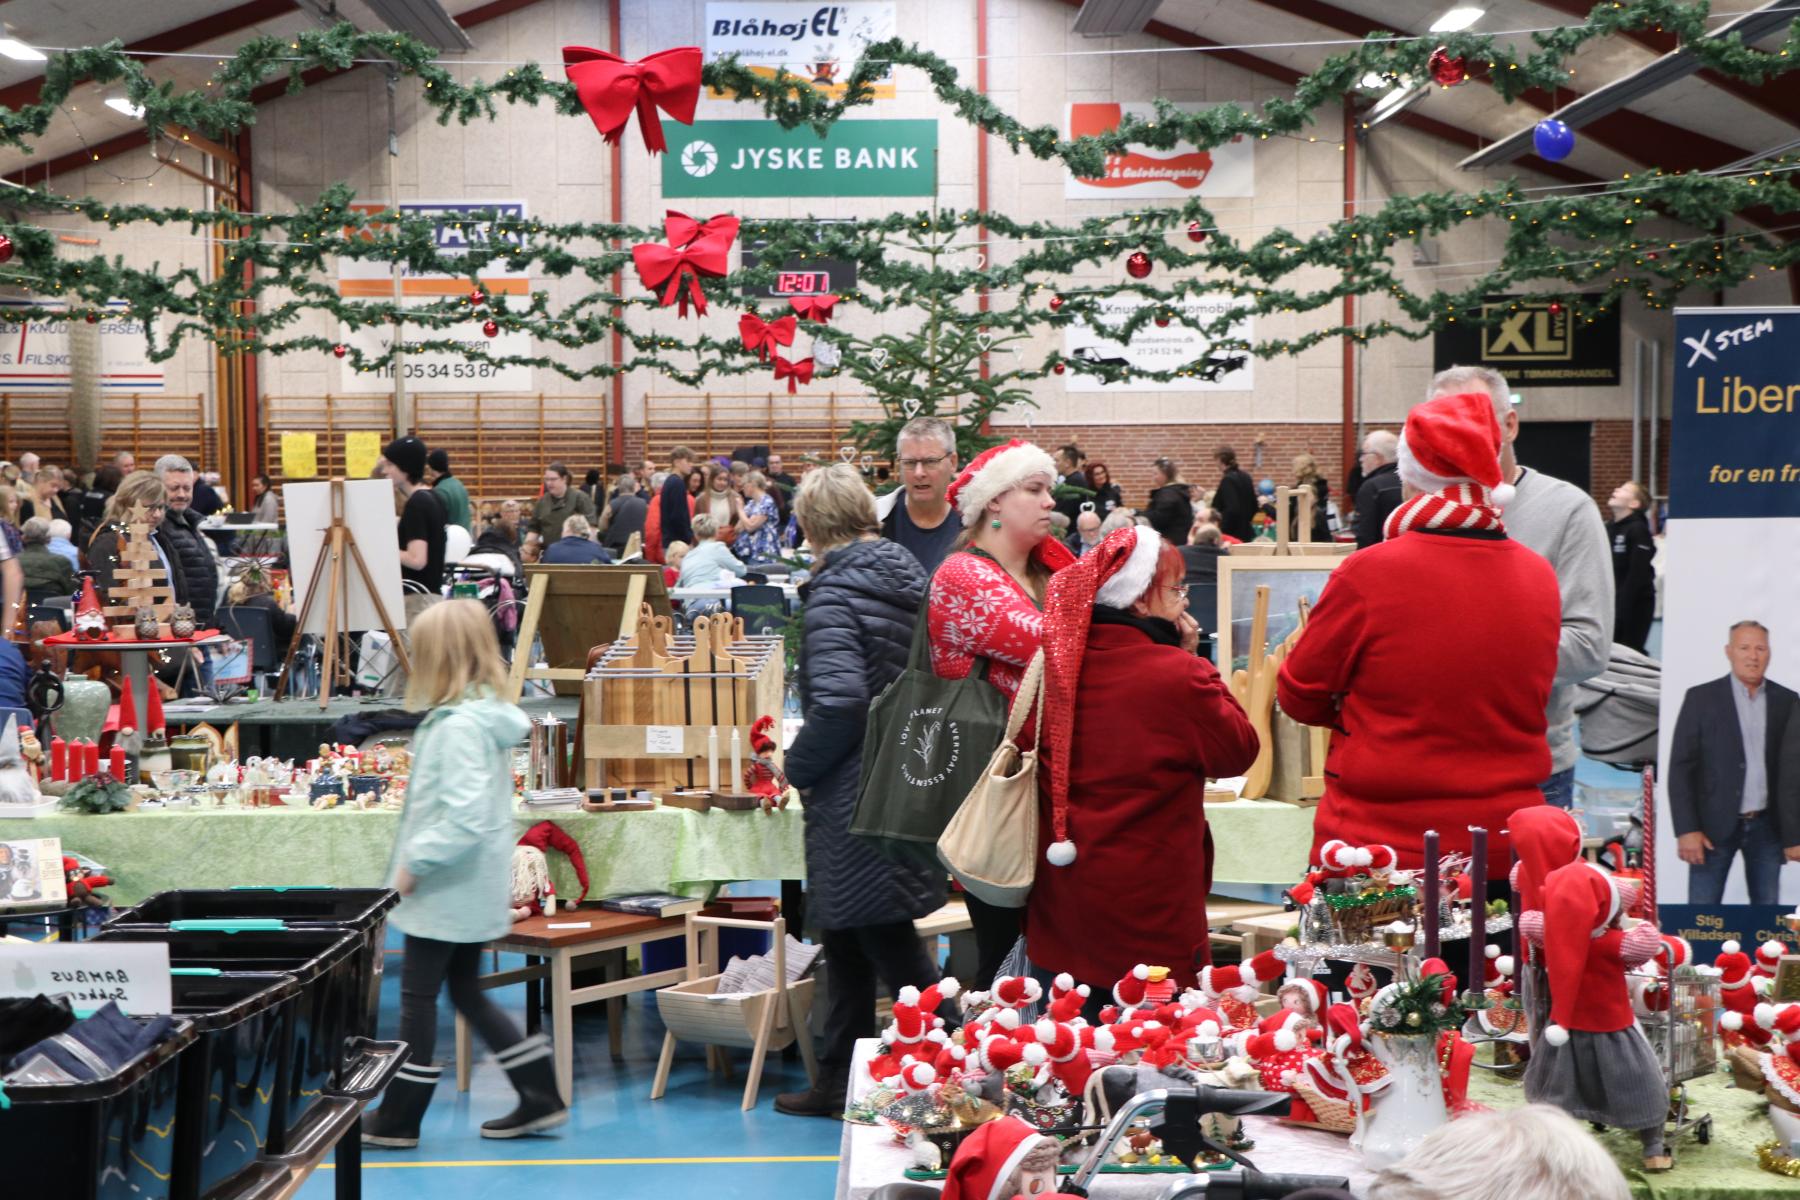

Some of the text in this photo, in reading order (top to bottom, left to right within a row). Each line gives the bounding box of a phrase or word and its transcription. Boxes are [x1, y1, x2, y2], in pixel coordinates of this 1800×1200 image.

[712, 18, 808, 41] Blåhøj
[730, 147, 919, 169] JYSKE BANK
[403, 208, 519, 244] TARK
[778, 273, 828, 292] 12:01
[29, 323, 69, 335] KNUD
[1488, 311, 1565, 353] XL
[1682, 318, 1774, 368] X STEM
[25, 353, 75, 366] FILSKO
[427, 363, 450, 379] 34
[453, 363, 476, 379] 53
[1709, 464, 1744, 484] for
[1747, 467, 1776, 483] en
[946, 721, 961, 774] EVERYDAY
[1695, 914, 1724, 929] Stig
[1678, 928, 1742, 941] Villadsen
